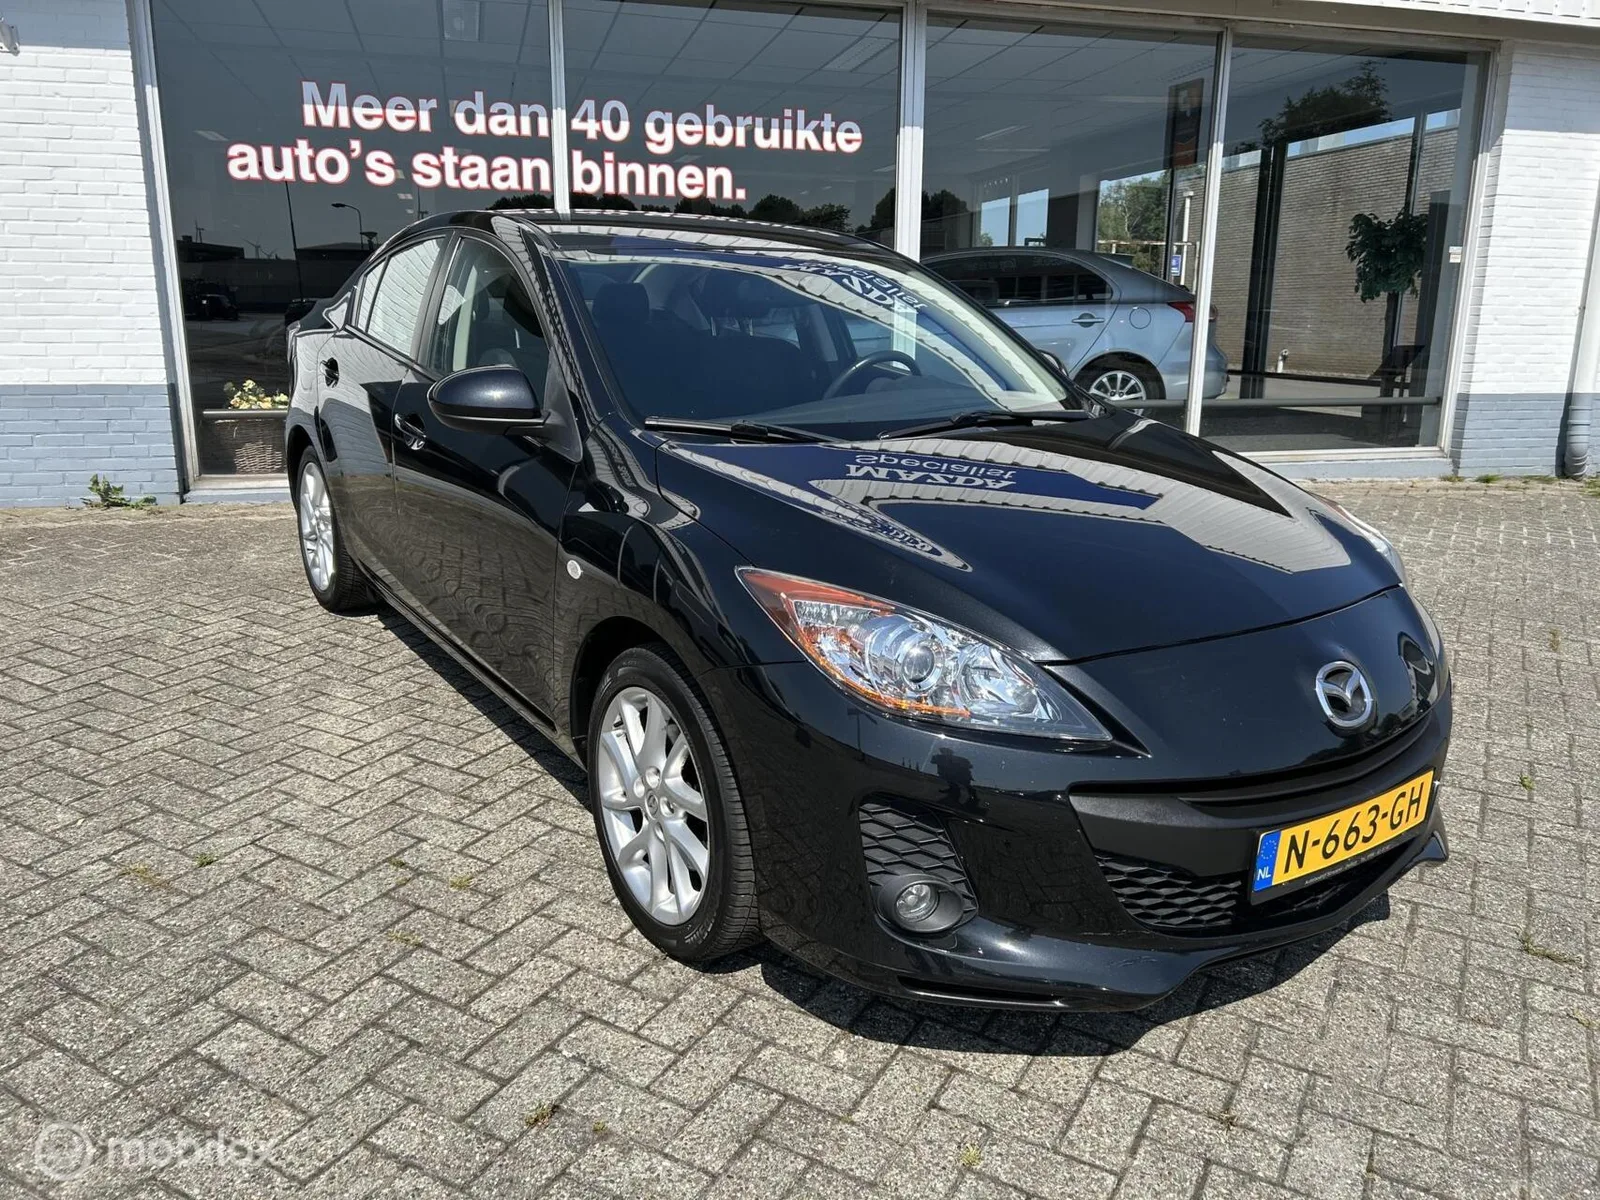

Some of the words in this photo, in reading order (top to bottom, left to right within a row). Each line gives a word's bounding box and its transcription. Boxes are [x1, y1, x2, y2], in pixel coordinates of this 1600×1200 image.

[300, 79, 437, 132] Meer
[454, 91, 550, 138] dan
[571, 98, 630, 141] 40
[645, 104, 863, 155] gebruikte
[226, 139, 396, 187] auto's
[411, 146, 550, 193] staan
[572, 150, 747, 200] binnen.
[1284, 781, 1424, 875] N-663-GH
[1257, 866, 1272, 881] NL
